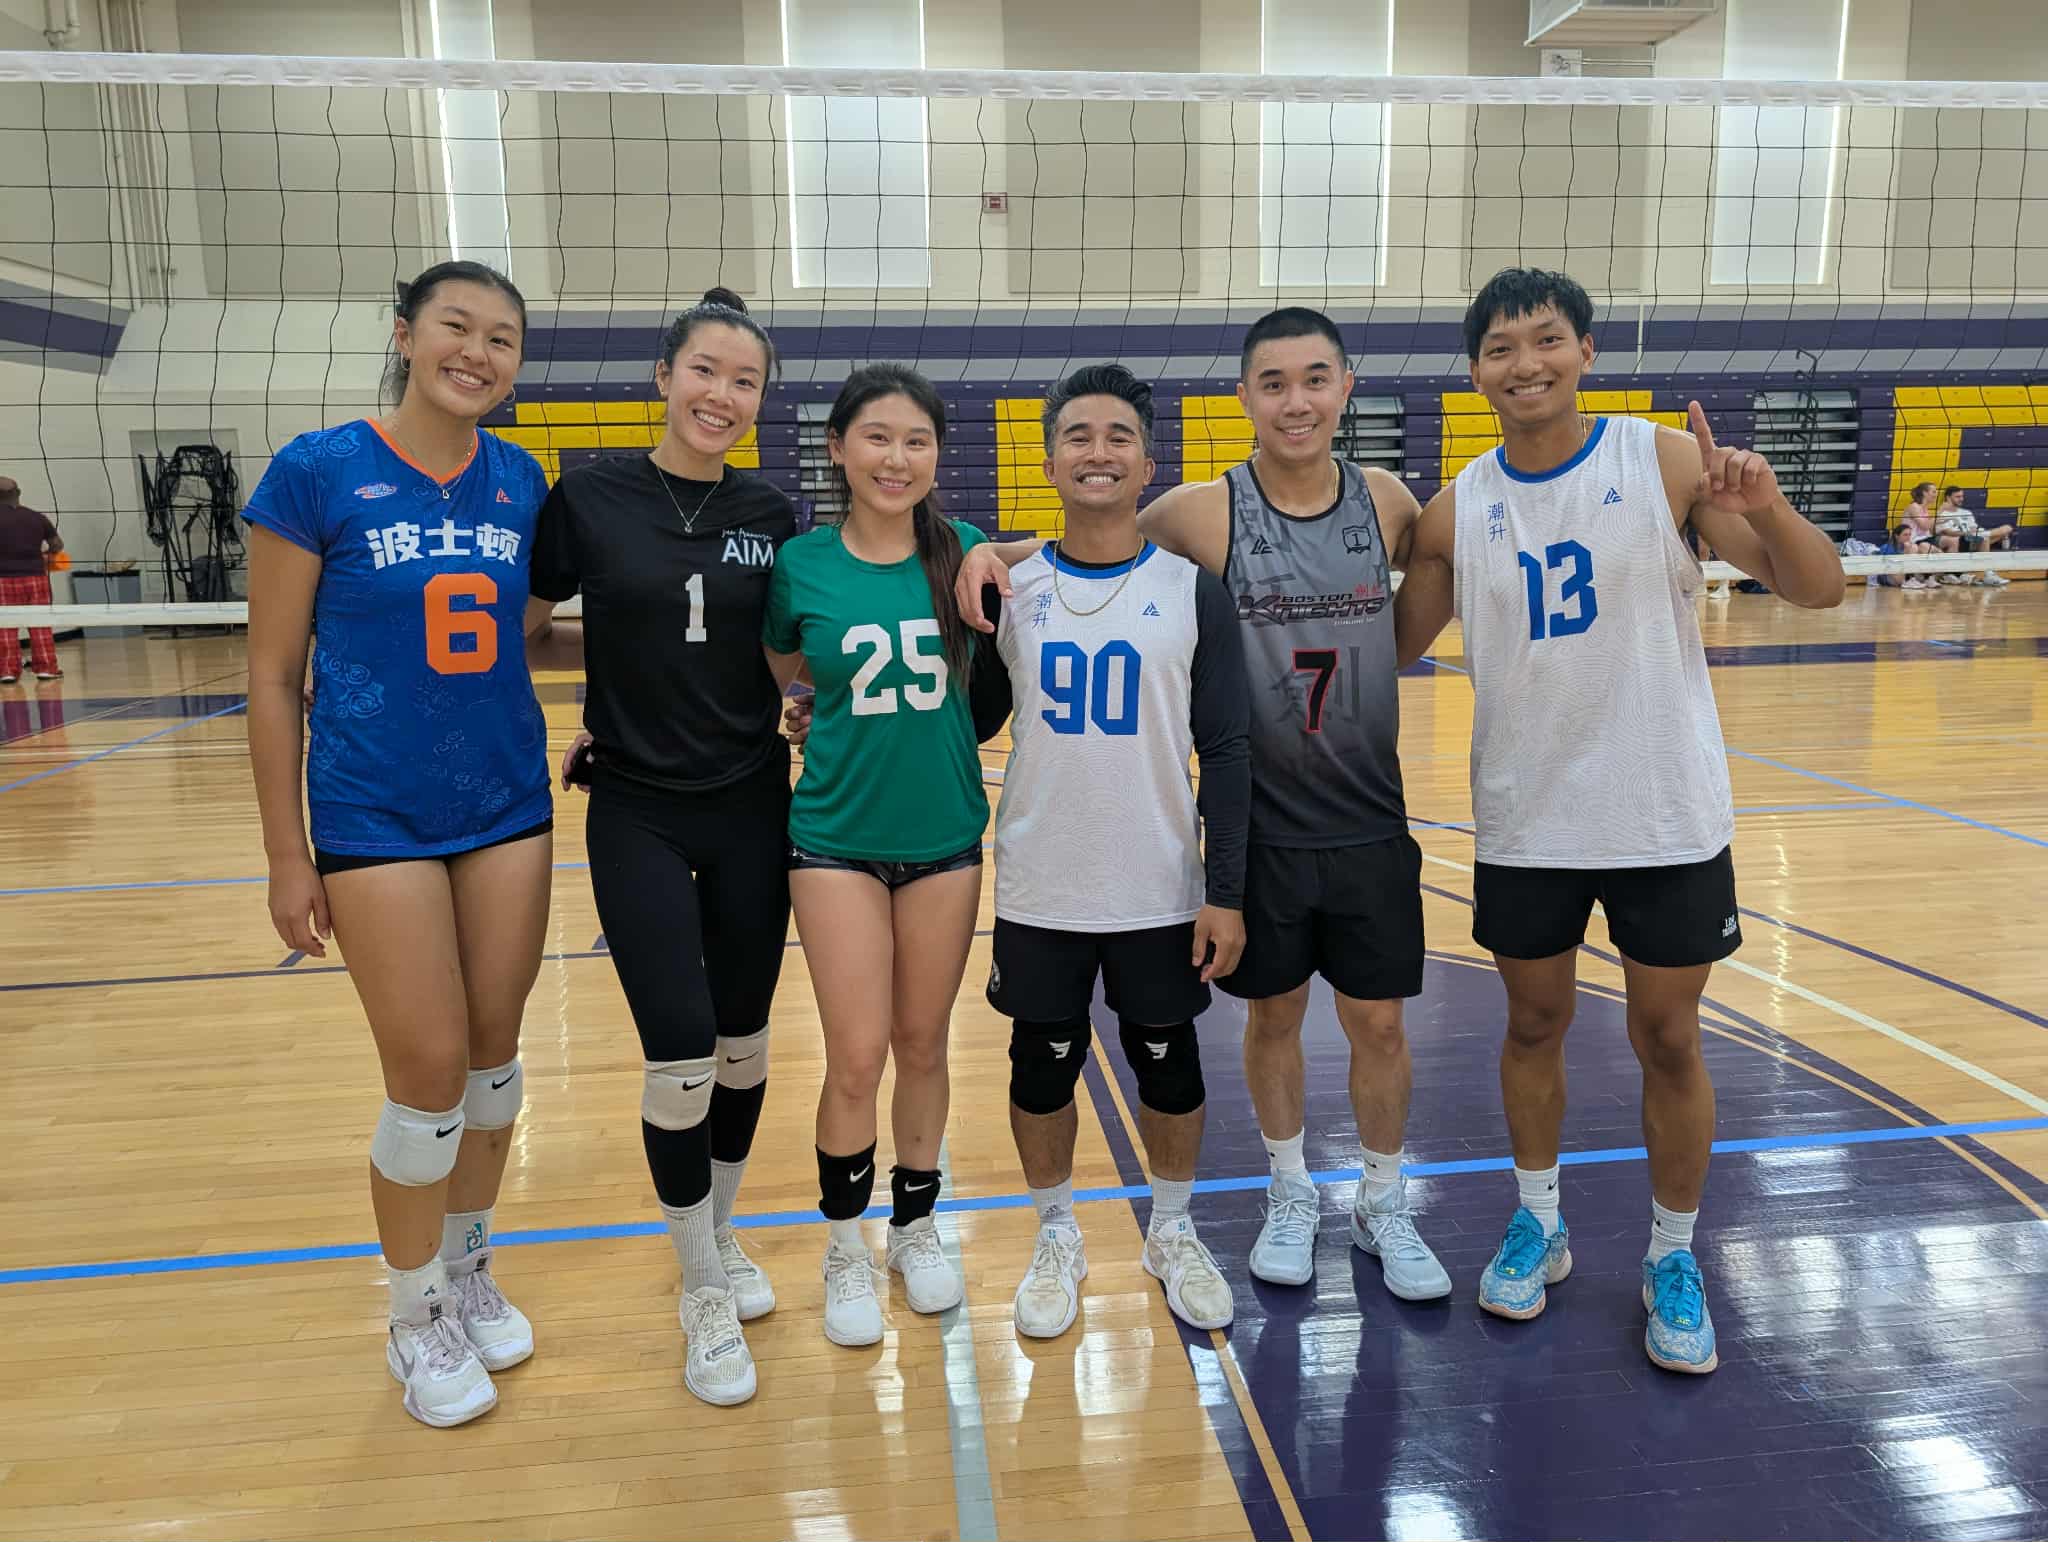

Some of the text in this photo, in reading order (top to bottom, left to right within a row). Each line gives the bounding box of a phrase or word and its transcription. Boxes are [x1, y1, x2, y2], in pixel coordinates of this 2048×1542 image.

[365, 518, 522, 570] 波士顿
[721, 538, 774, 568] AIM
[424, 573, 498, 675] 6
[685, 574, 707, 642] 1
[1518, 540, 1598, 641] 13
[841, 619, 949, 716] 25
[1040, 640, 1142, 736] 90
[1291, 648, 1338, 735] 7
